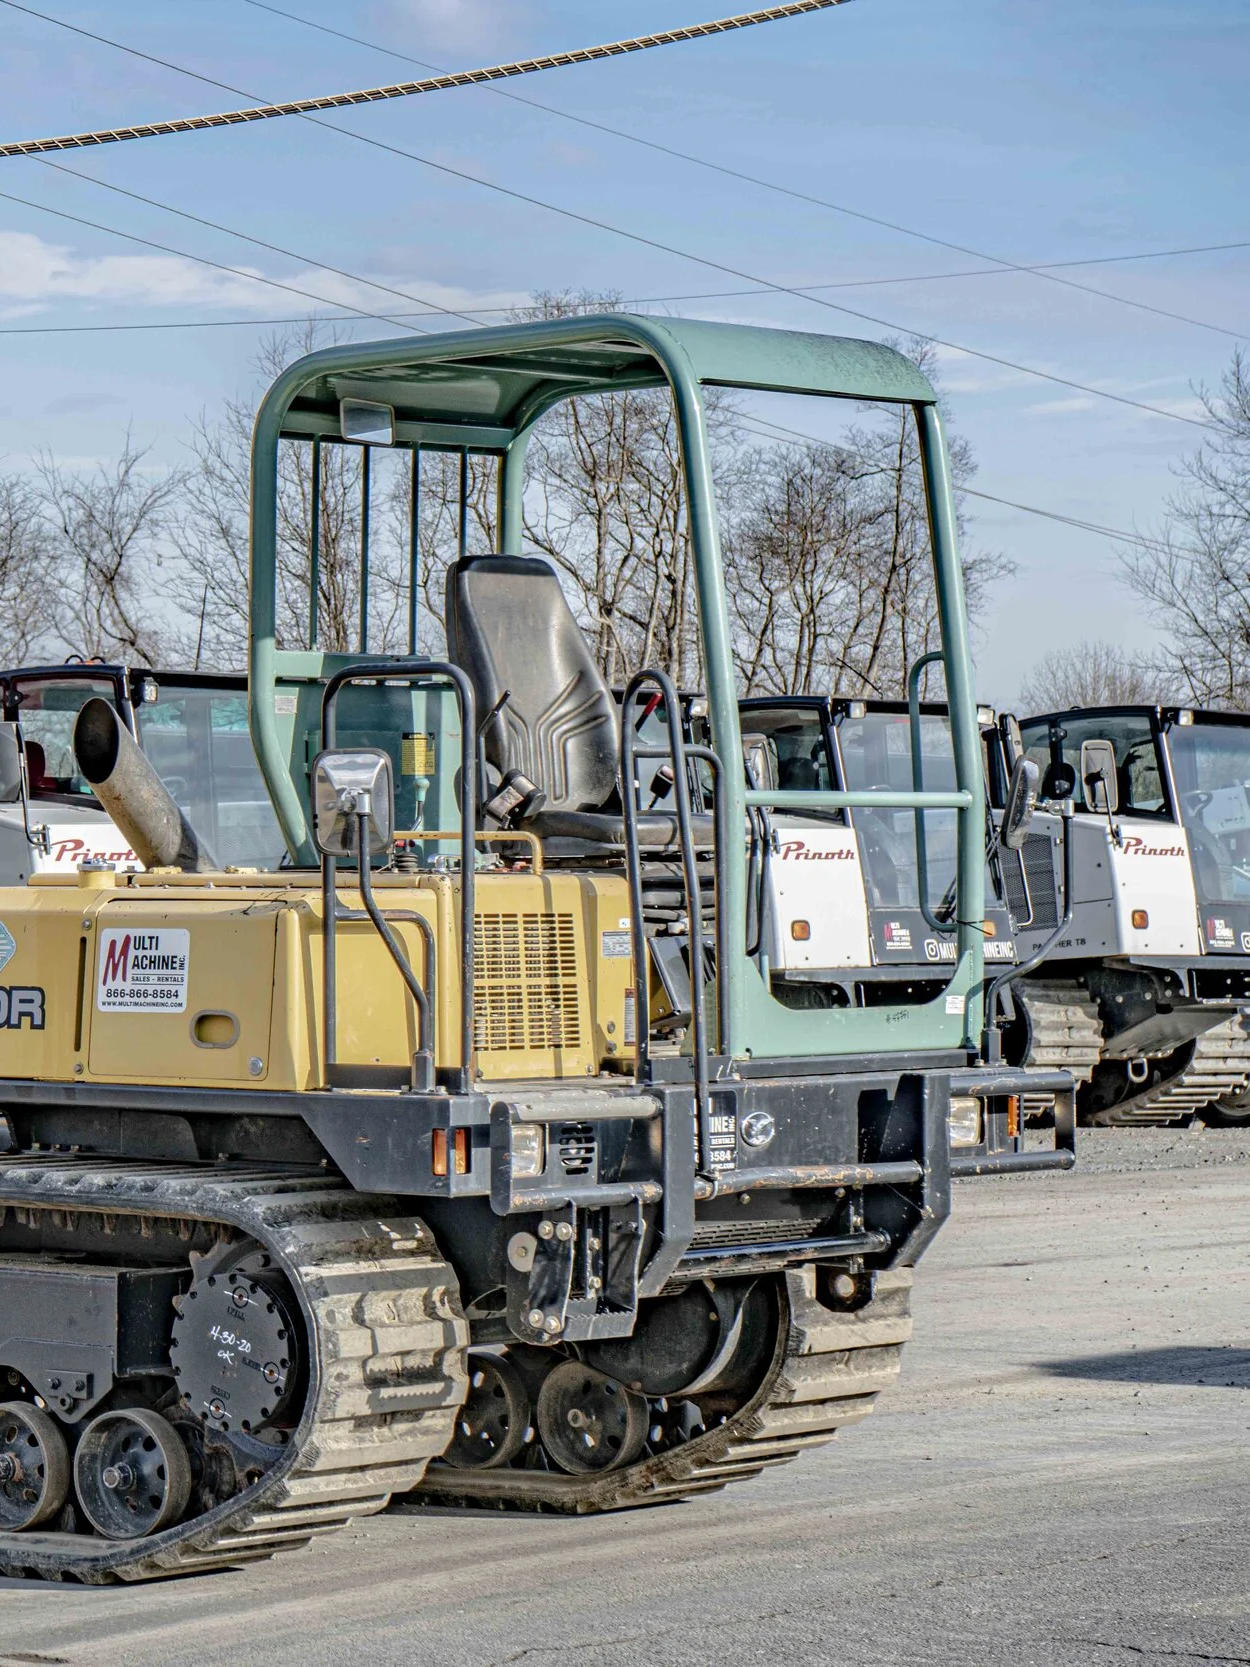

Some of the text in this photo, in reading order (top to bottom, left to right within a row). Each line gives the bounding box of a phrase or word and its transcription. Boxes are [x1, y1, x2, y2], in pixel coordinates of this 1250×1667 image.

[51, 839, 138, 861] Prinot
[780, 841, 854, 860] Prinoth
[1122, 836, 1185, 856] Prinoth
[1032, 939, 1072, 951] PAHER
[106, 988, 180, 999] 866-866-8584
[101, 1000, 183, 1008] WWW.MULTIMACHINEINC.COM
